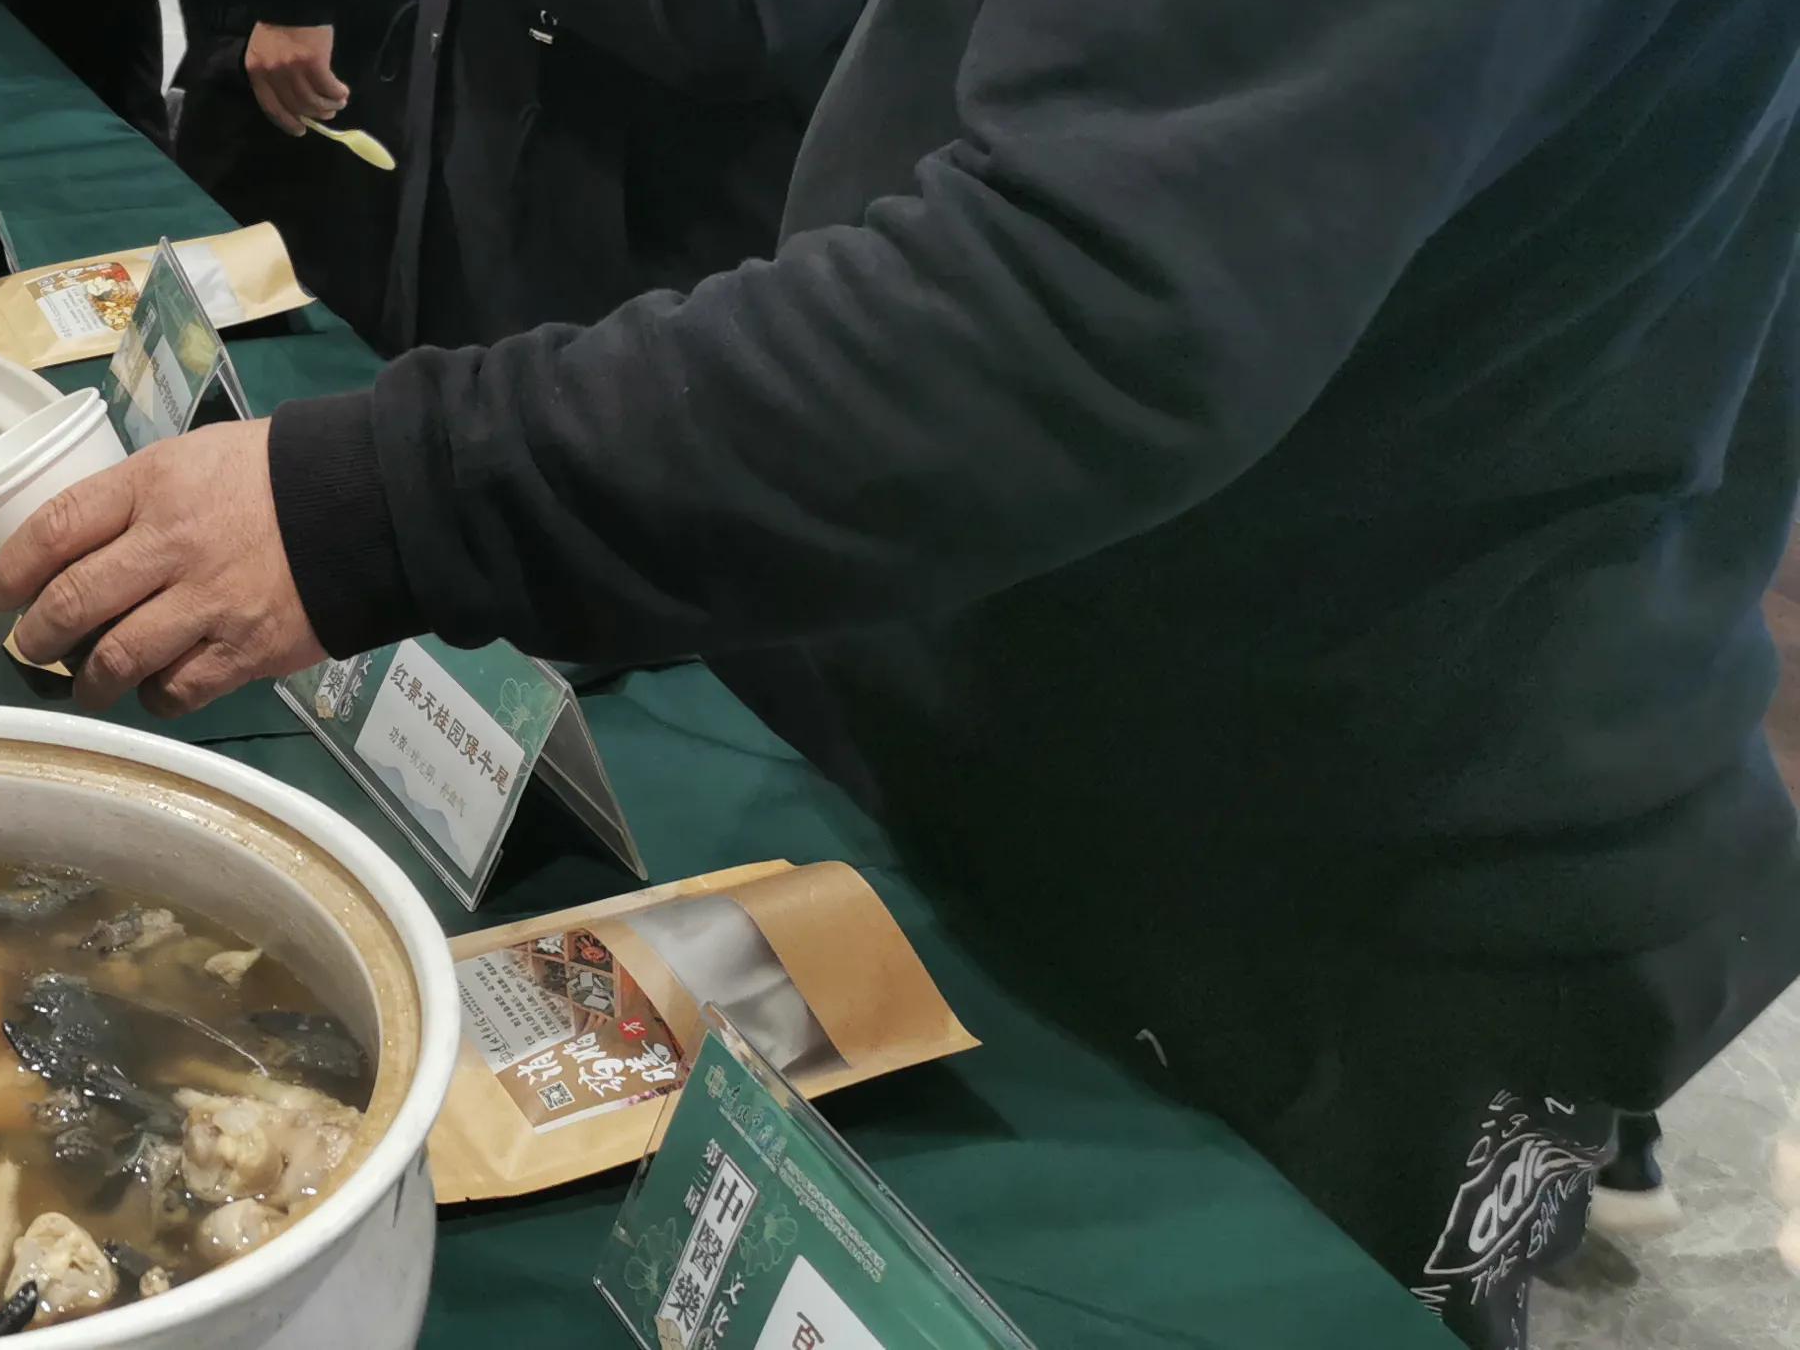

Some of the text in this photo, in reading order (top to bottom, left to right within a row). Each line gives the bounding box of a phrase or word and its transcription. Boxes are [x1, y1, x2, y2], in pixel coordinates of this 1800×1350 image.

[390, 663, 510, 796] 红景天桂园煲牛尾
